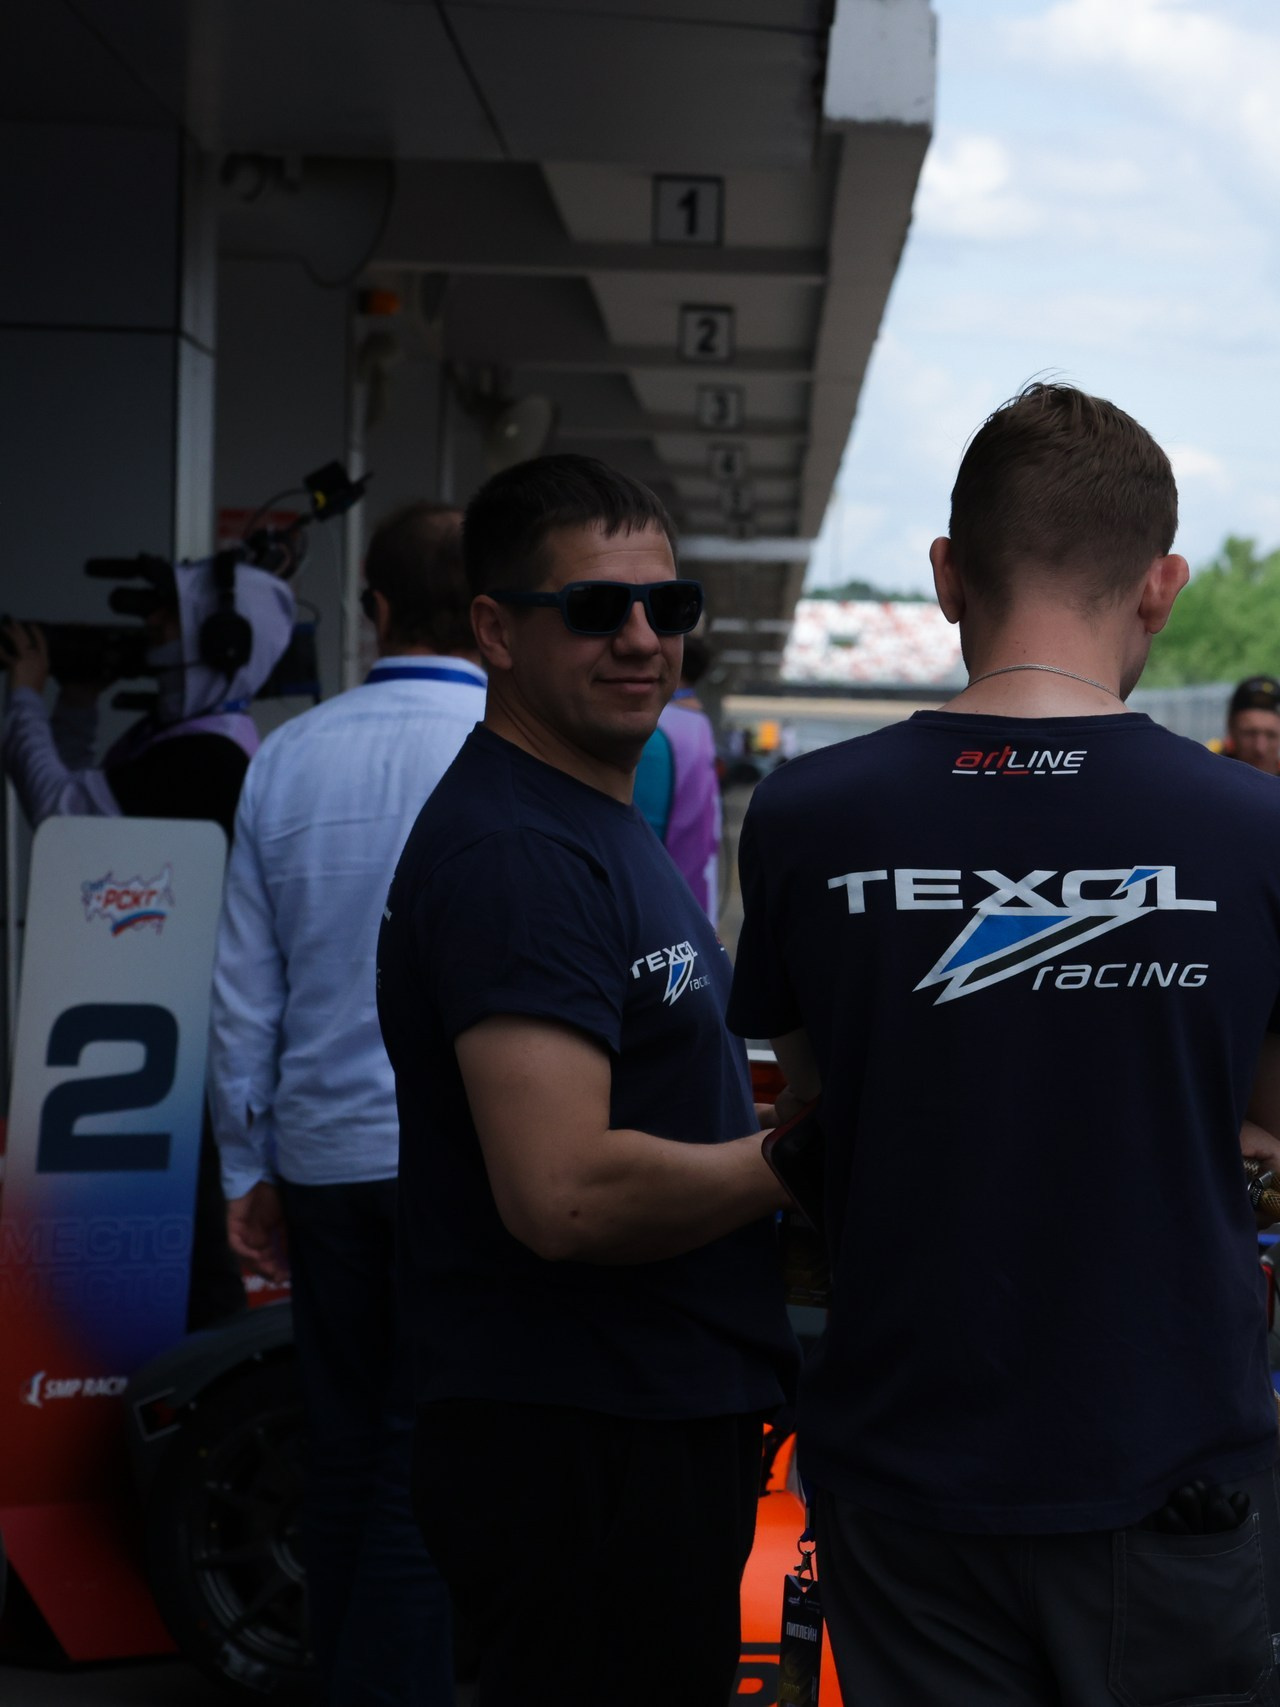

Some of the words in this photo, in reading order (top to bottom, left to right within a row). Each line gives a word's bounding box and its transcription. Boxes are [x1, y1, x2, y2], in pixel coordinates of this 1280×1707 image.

[677, 188, 699, 236] 1
[697, 317, 717, 353] 2
[828, 865, 1217, 914] TEXOL
[36, 1003, 179, 1173] 2
